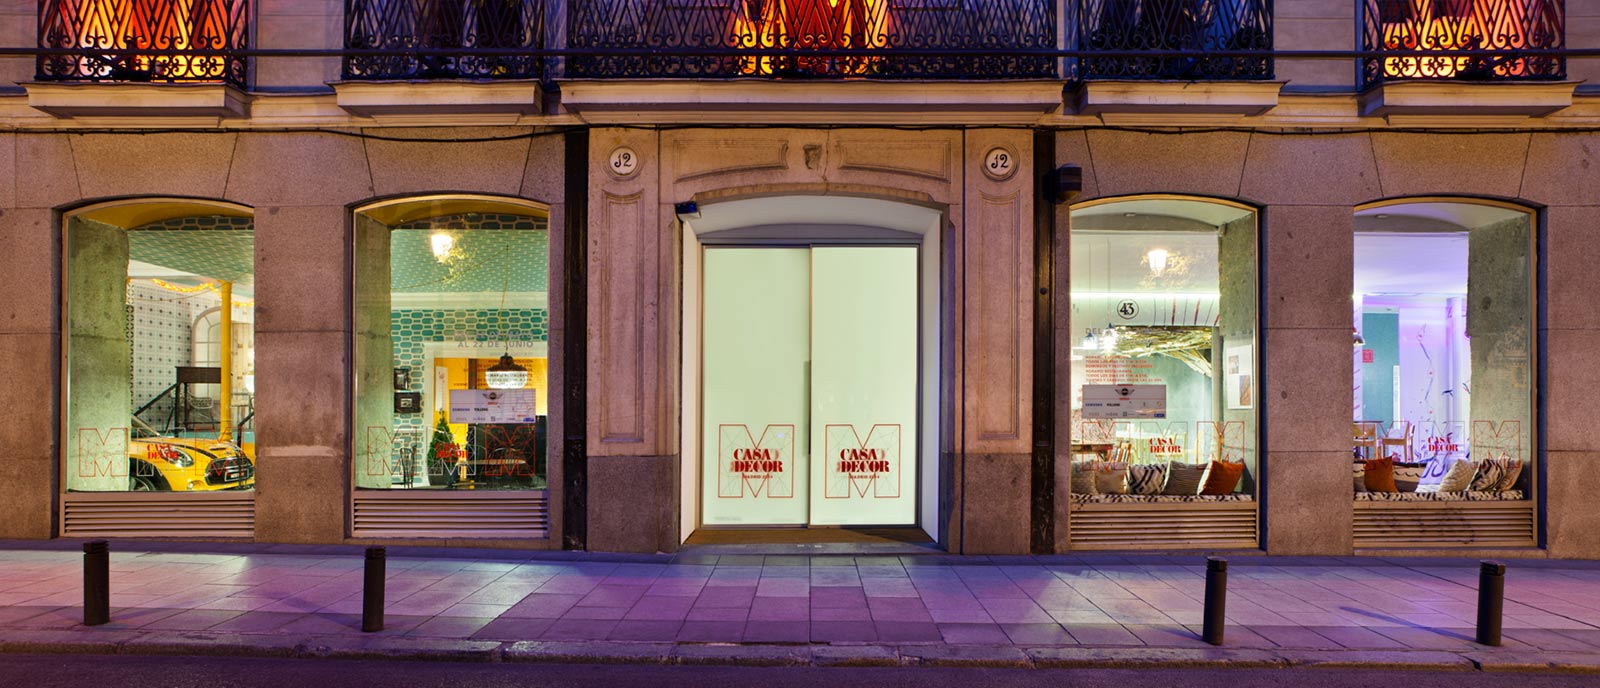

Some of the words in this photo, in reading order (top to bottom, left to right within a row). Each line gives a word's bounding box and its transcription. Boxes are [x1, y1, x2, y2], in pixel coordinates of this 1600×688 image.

[1119, 302, 1135, 316] 43
[1149, 437, 1174, 445] CASA
[733, 448, 771, 461] CASA
[840, 448, 878, 461] CASA
[1149, 445, 1182, 453] DECOR
[718, 424, 795, 498] M
[734, 460, 784, 473] DECOR
[825, 424, 901, 498] M
[841, 460, 890, 473] DECOR
